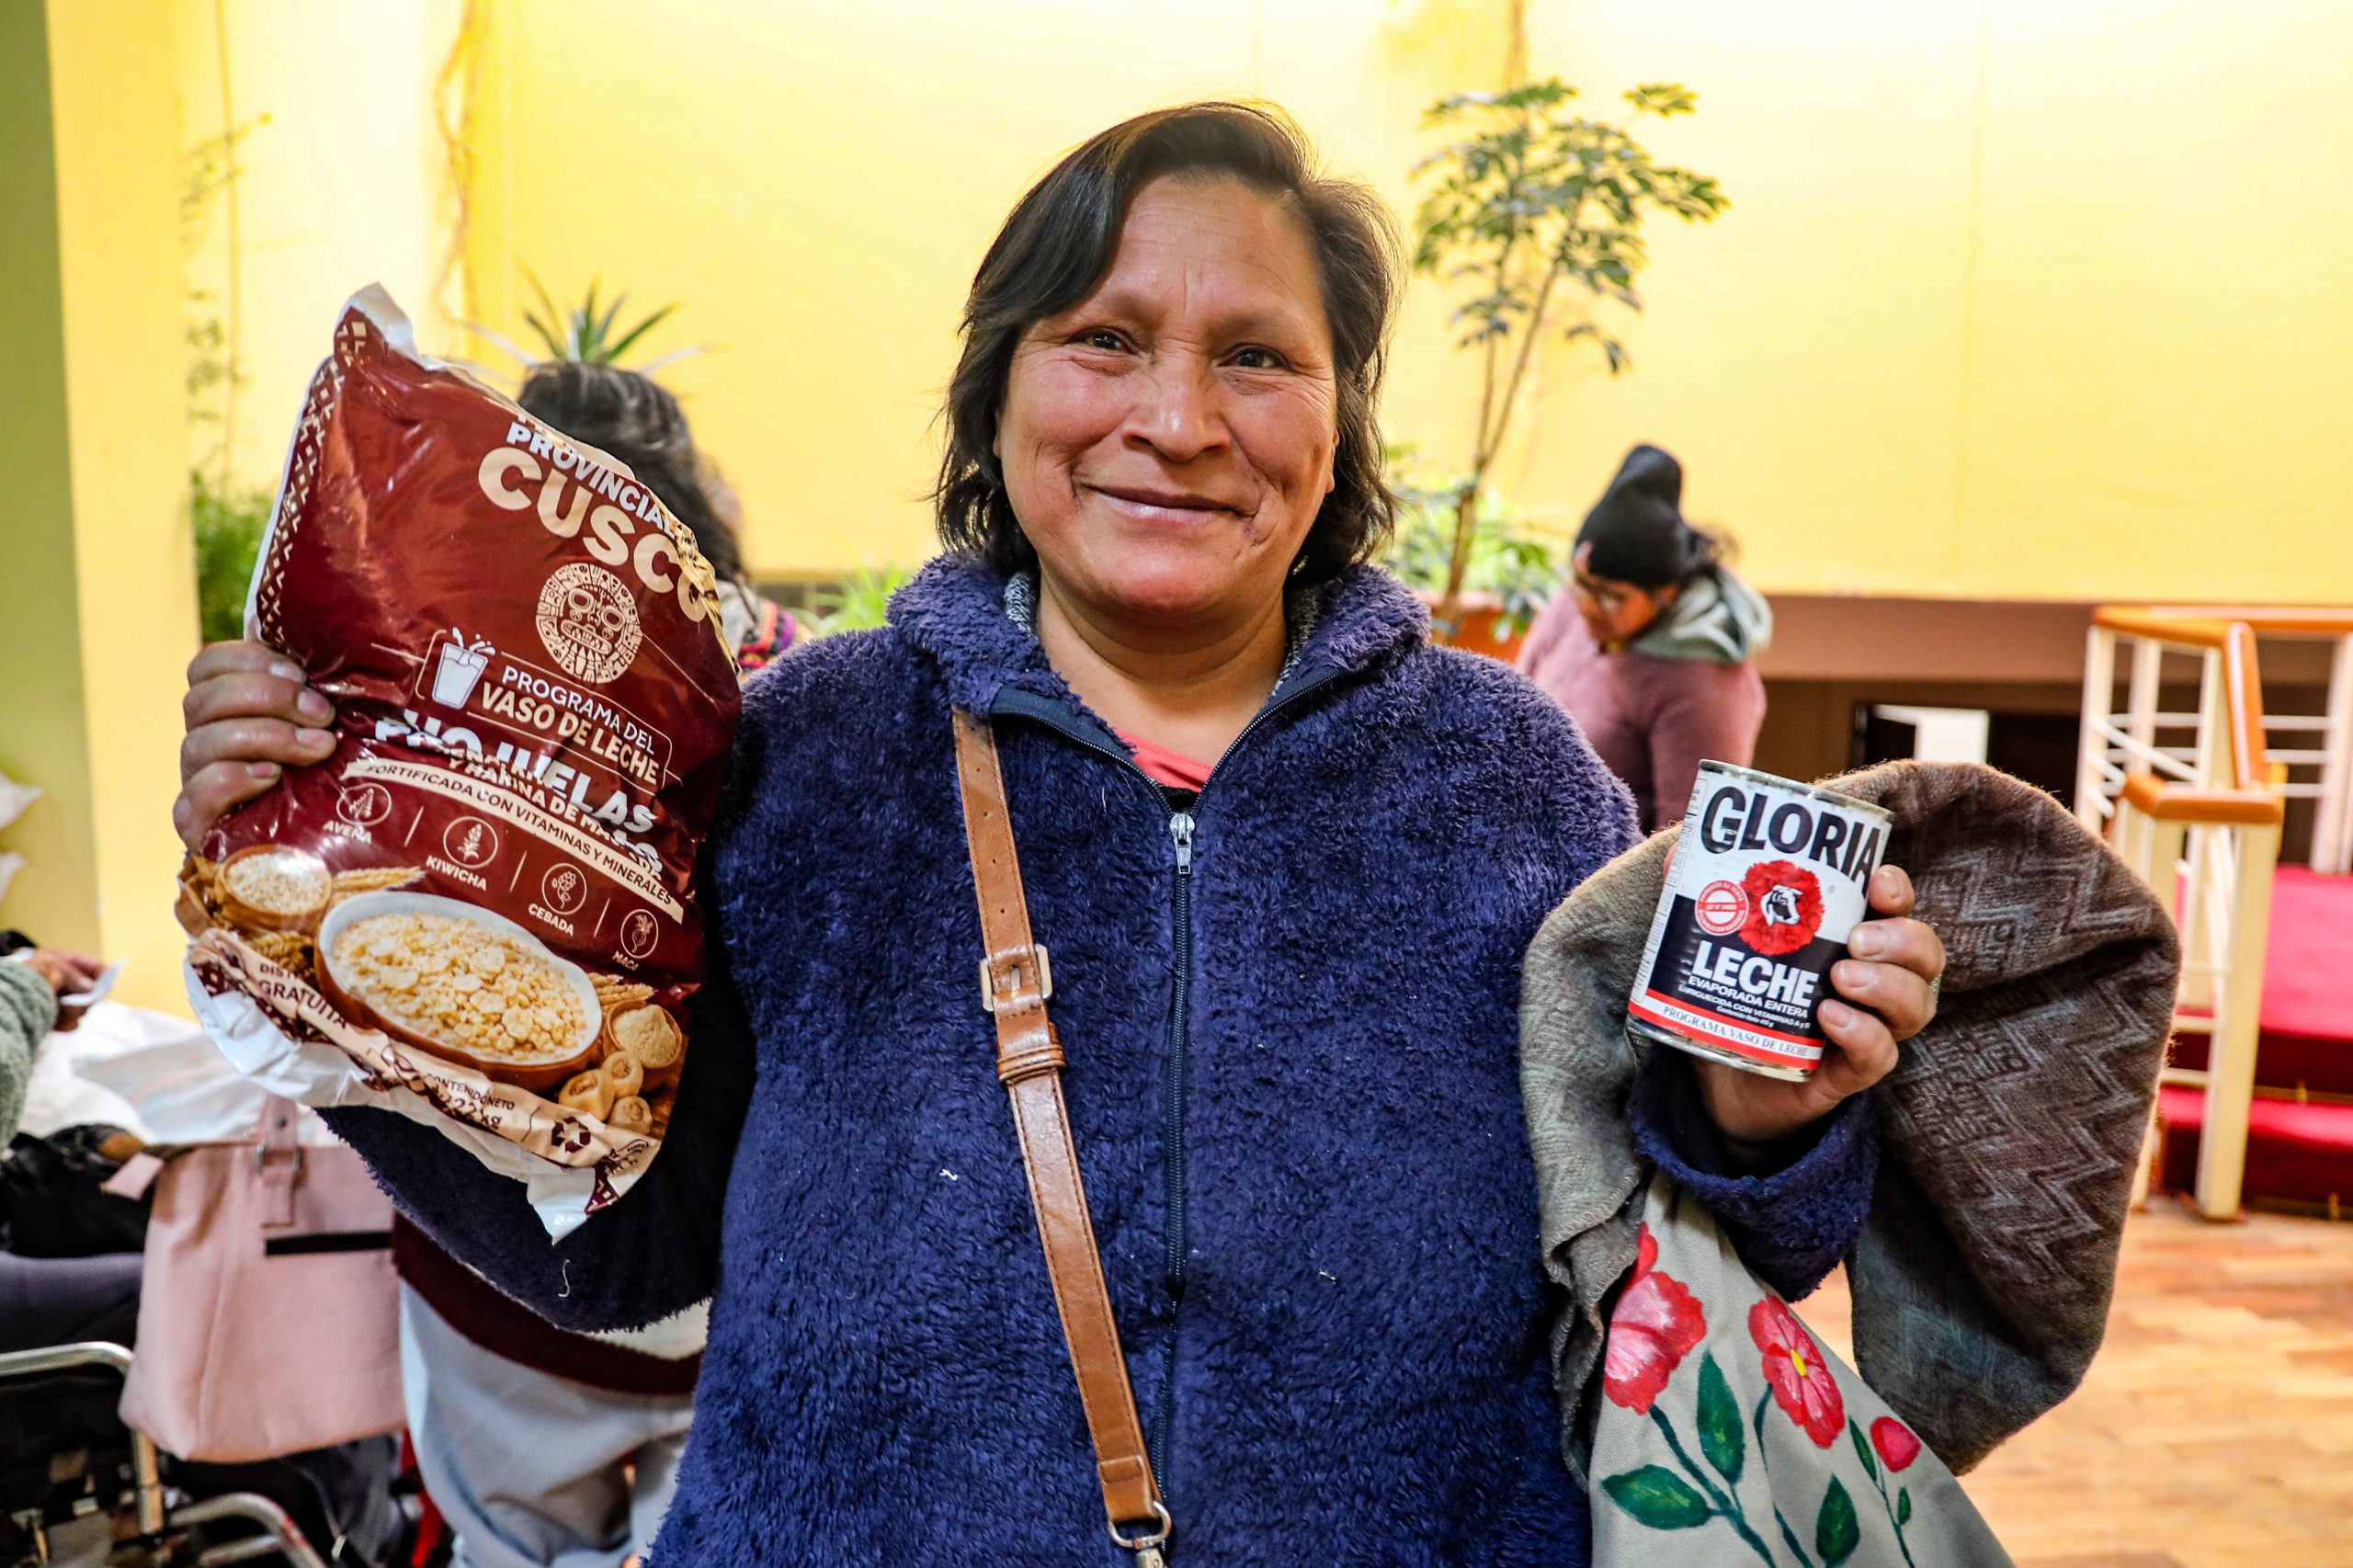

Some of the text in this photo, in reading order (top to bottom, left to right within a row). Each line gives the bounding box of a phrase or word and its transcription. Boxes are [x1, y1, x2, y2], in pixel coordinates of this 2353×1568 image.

[506, 421, 676, 540] PROVINCIAL
[478, 447, 710, 622] CUSCO
[483, 682, 555, 729] VASO
[558, 713, 592, 745] DE
[591, 728, 660, 785] LECHE
[503, 665, 620, 733] PROGRAMA
[624, 722, 655, 755] DEL
[323, 820, 372, 845] AVENA
[550, 795, 579, 823] DE
[367, 765, 472, 796] FORTIFICADA
[476, 788, 513, 813] CON
[516, 806, 591, 856] VITAMINAS
[593, 847, 603, 861] Y
[602, 855, 672, 904] MINERALES
[1700, 786, 1881, 900] GLORIA
[426, 855, 487, 892] KIWICHA
[529, 903, 574, 937] CEBADA
[612, 950, 640, 971] MACA
[1692, 939, 1819, 1008] LECHE
[258, 980, 347, 1029] GRATUITA
[1688, 975, 1809, 1019] EVAPORADA ENTERA
[1733, 1002, 1753, 1014] CON
[1753, 1008, 1795, 1027] VITAMINAS
[1663, 1006, 1808, 1057] PROGRAMA VASO DE LECHE
[426, 1073, 515, 1110] CONTENIDO NETO
